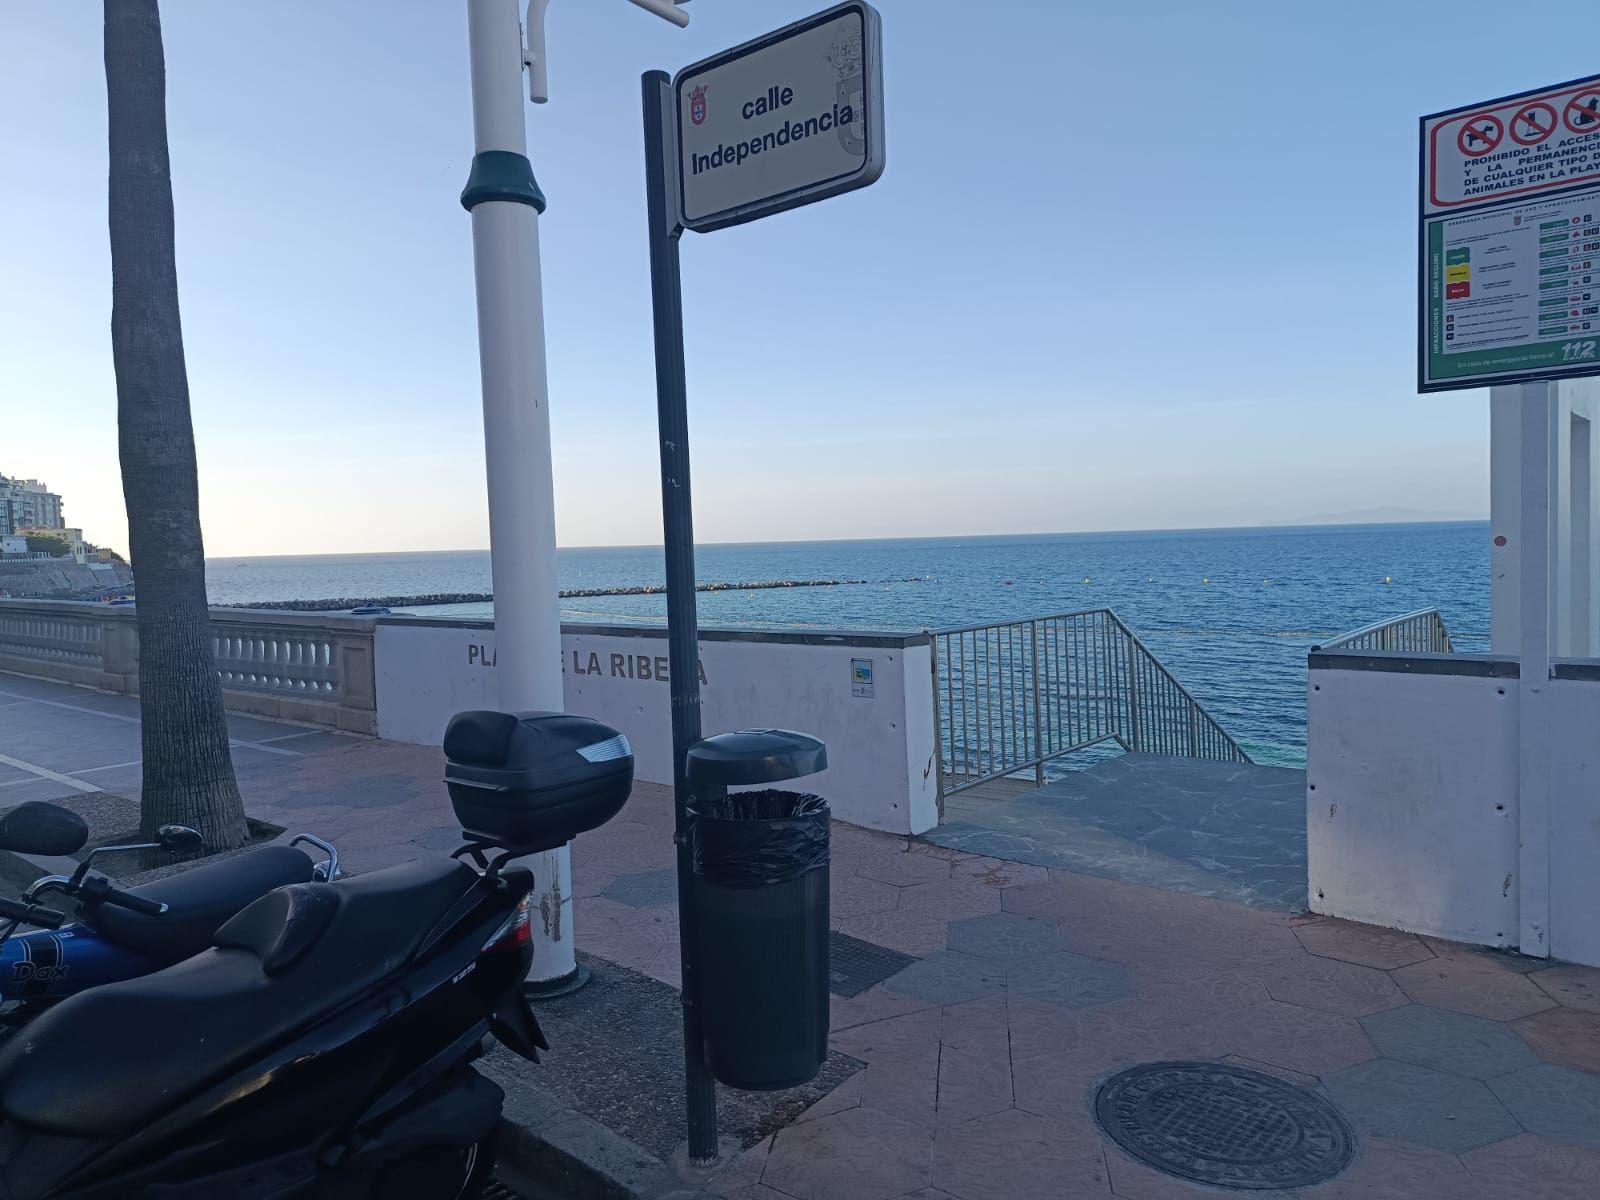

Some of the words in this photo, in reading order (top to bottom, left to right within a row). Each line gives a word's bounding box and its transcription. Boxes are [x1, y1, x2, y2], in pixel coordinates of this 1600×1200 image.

[742, 86, 794, 120] calle
[692, 103, 854, 175] Independencia
[1464, 148, 1530, 167] PROHIBIDO
[1536, 144, 1552, 152] EL
[1463, 177, 1525, 196] ANIMALES
[1528, 173, 1546, 183] EN
[1549, 168, 1566, 179] LA
[1464, 169, 1472, 177] Y
[1487, 163, 1503, 172] LA
[1464, 177, 1479, 187] DE
[1483, 162, 1554, 183] CUALQUIER
[1558, 154, 1588, 167] TIPO
[1561, 340, 1597, 361] 112
[573, 650, 602, 676] LA
[610, 653, 708, 685] RIBEA
[9, 960, 71, 983] Dax
